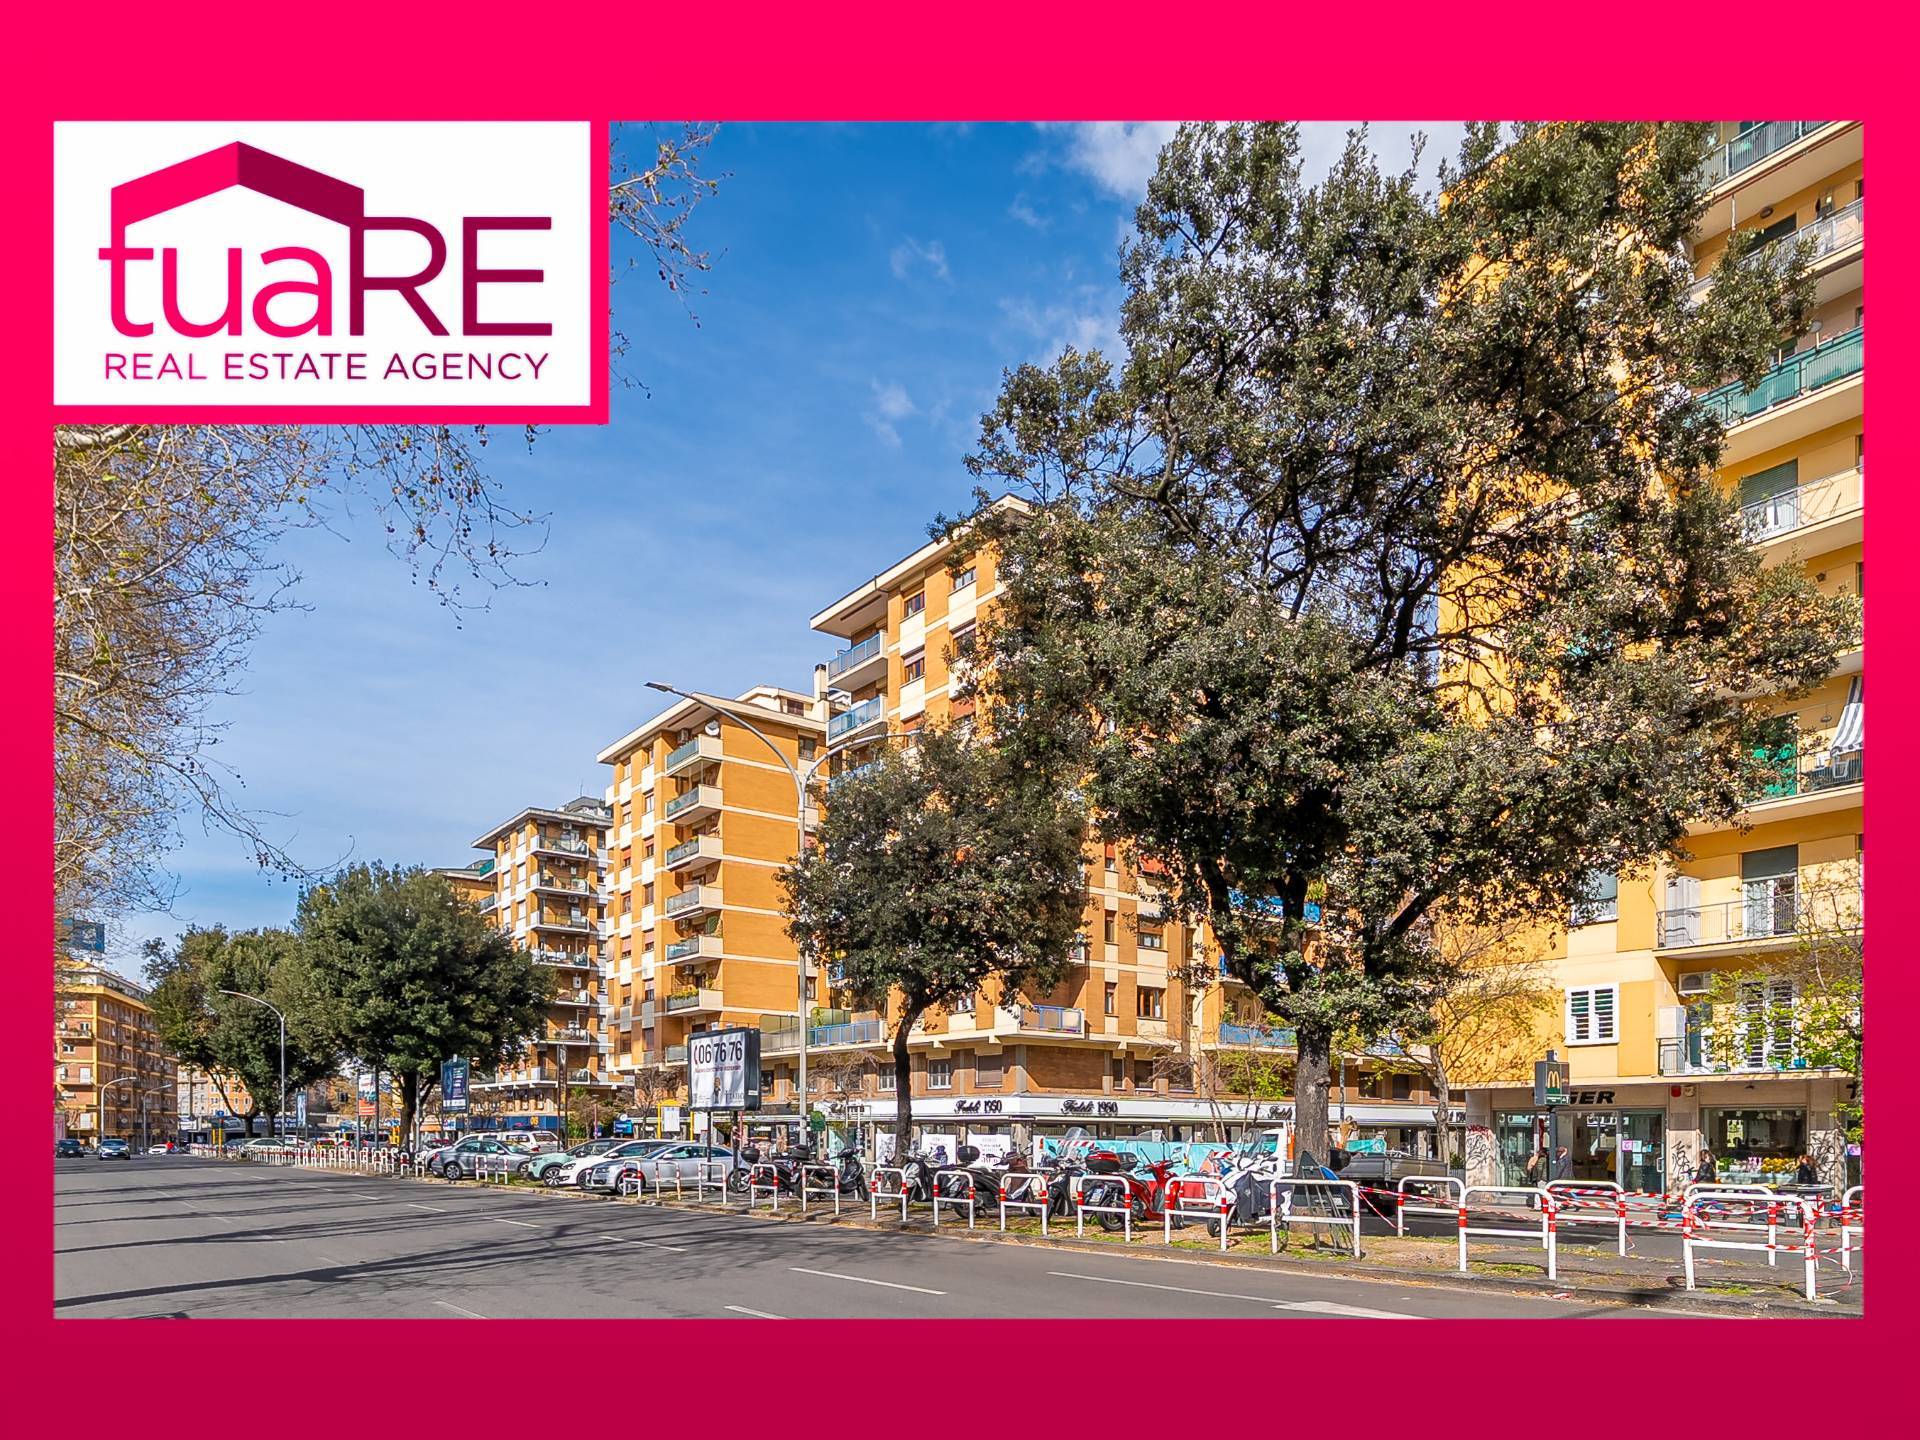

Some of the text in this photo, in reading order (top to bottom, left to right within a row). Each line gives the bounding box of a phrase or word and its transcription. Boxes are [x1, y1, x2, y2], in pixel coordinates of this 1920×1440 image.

[698, 1041, 743, 1064] 06 76 76
[984, 1099, 1003, 1114] 1950
[1097, 1101, 1119, 1116] 1950
